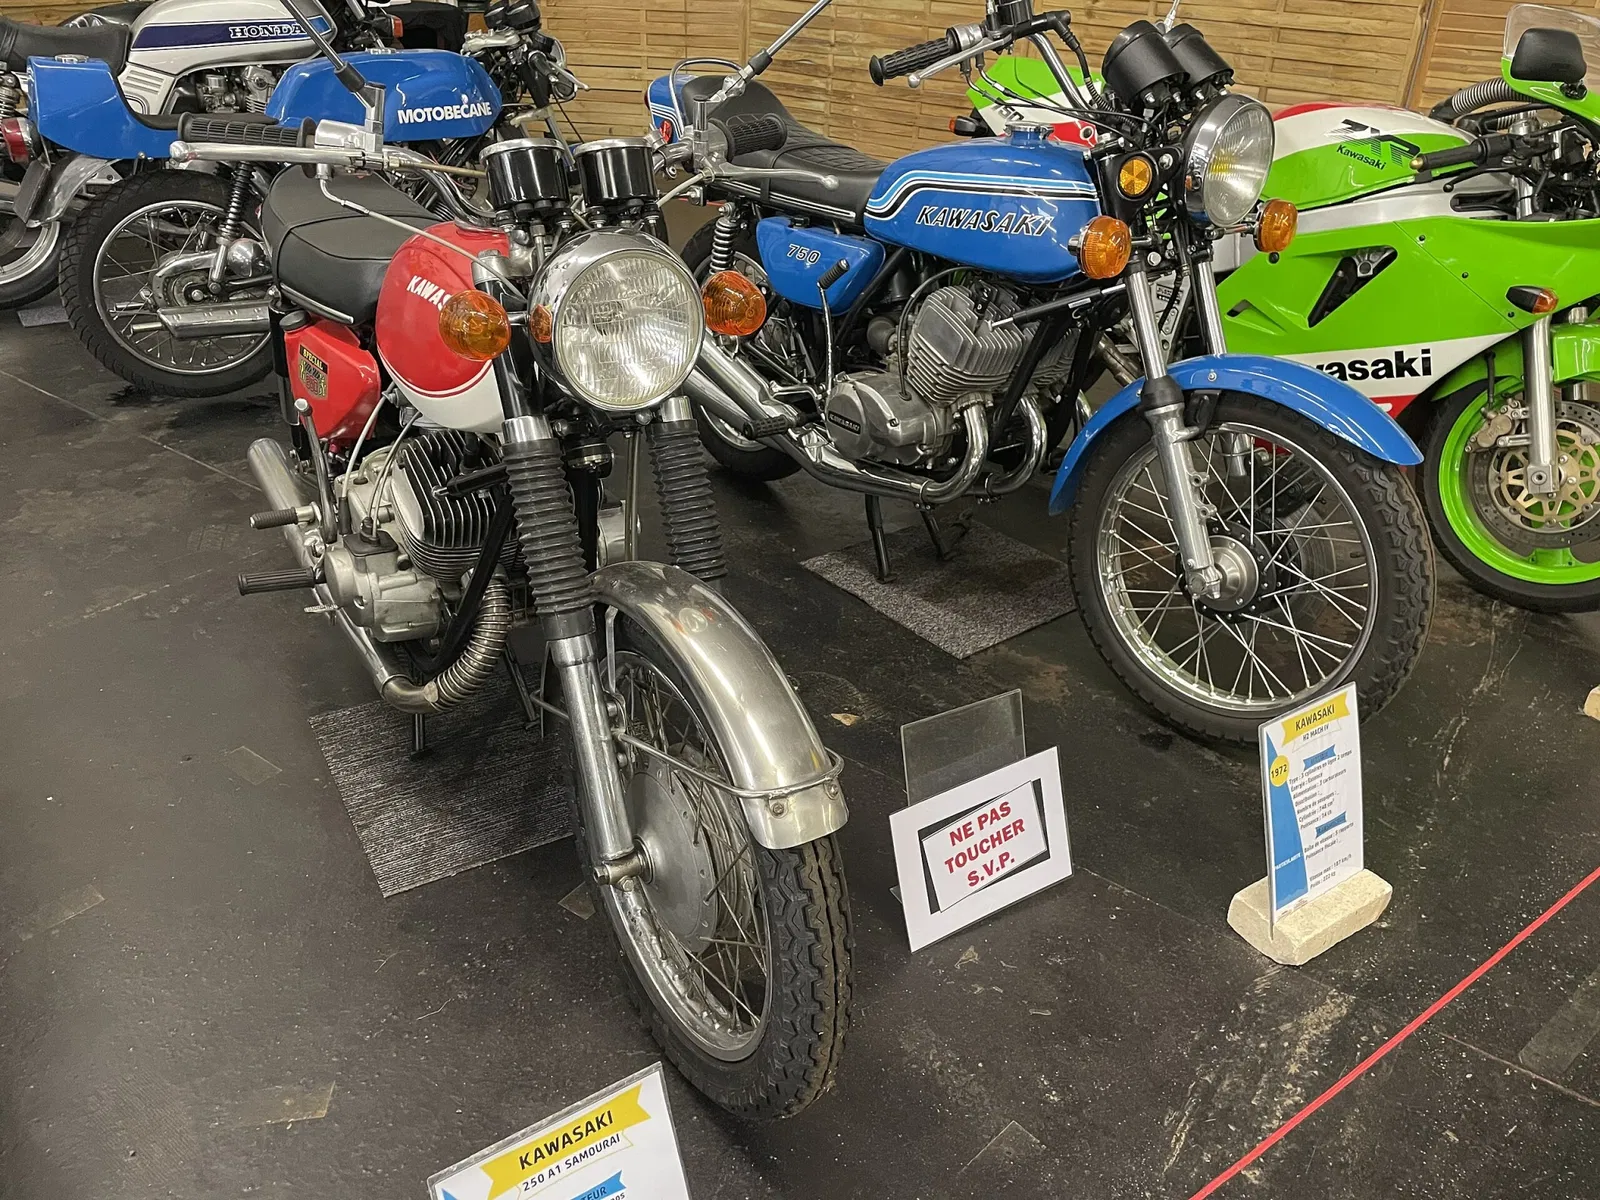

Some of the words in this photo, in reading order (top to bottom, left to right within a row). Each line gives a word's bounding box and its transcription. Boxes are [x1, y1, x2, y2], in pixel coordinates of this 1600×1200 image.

[229, 24, 307, 38] HONDA
[397, 102, 492, 124] MOTOBECANE
[1336, 145, 1386, 170] Kawasaki
[916, 205, 1054, 237] KAWASAKI
[787, 244, 821, 265] 750
[303, 348, 324, 371] SPECIAL
[1295, 703, 1334, 732] KAWASAKI
[1303, 733, 1308, 742] H2
[1310, 726, 1323, 738] MACH
[1271, 764, 1287, 780] 1972
[950, 821, 975, 846] NE
[977, 801, 1012, 831] PAS
[945, 818, 1025, 873] TOUCHER
[967, 851, 1015, 887] S.V.P.
[518, 1109, 614, 1170] KAWASAKI
[523, 1173, 545, 1192] 250
[548, 1165, 562, 1179] A1
[564, 1133, 620, 1169] SAMOURAI
